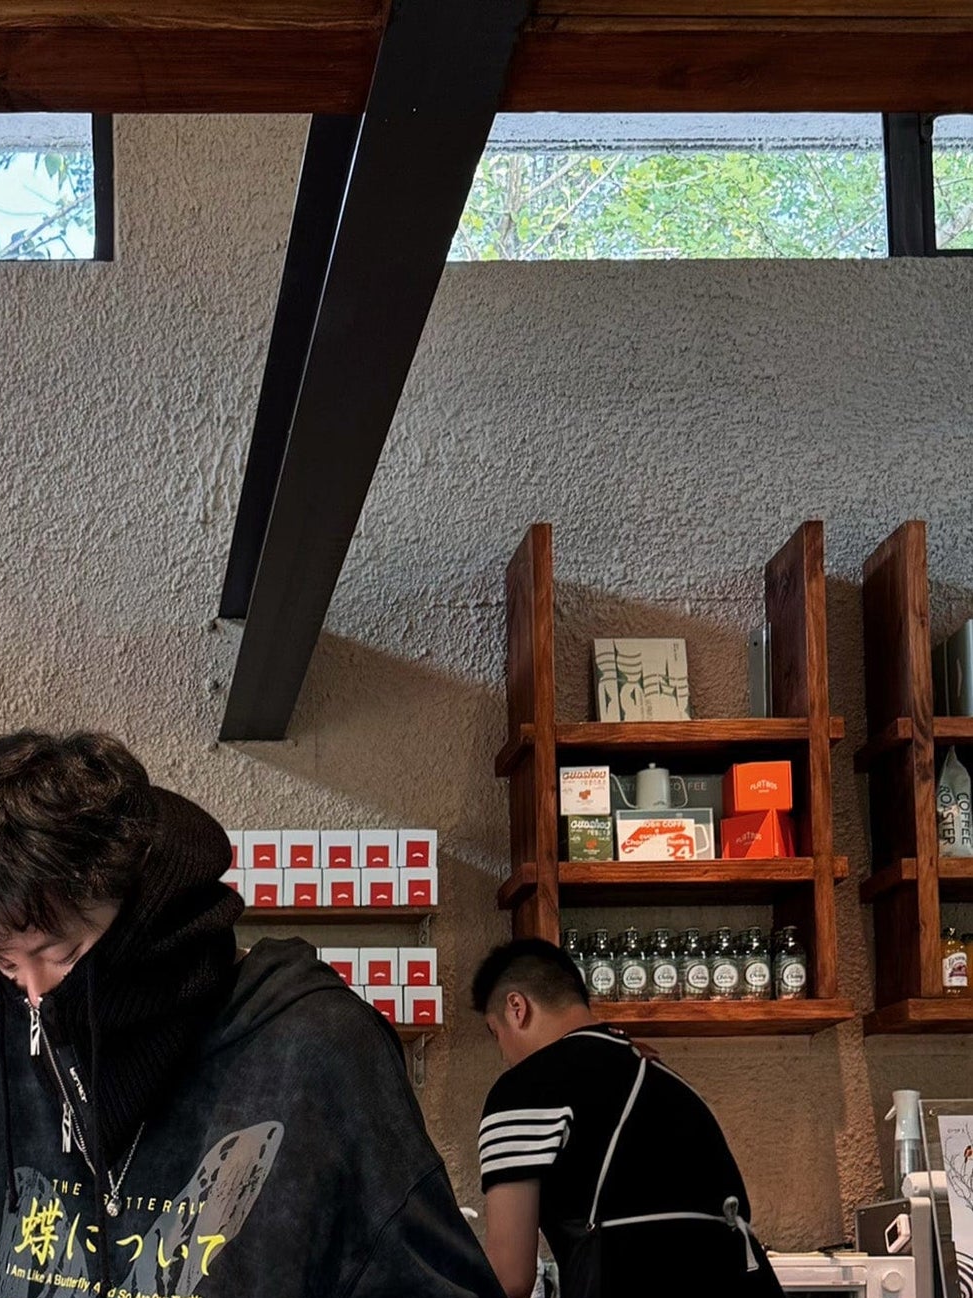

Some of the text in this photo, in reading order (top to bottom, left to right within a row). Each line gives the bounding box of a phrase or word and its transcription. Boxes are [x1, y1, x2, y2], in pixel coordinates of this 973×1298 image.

[52, 1179, 206, 1215] THE TTERFLY
[14, 1197, 226, 1276] 蝶について
[11, 1264, 25, 1279] Am
[27, 1268, 45, 1283] Like
[46, 1273, 53, 1284] A
[54, 1273, 90, 1293] Butterfly
[93, 1281, 116, 1298] Ad
